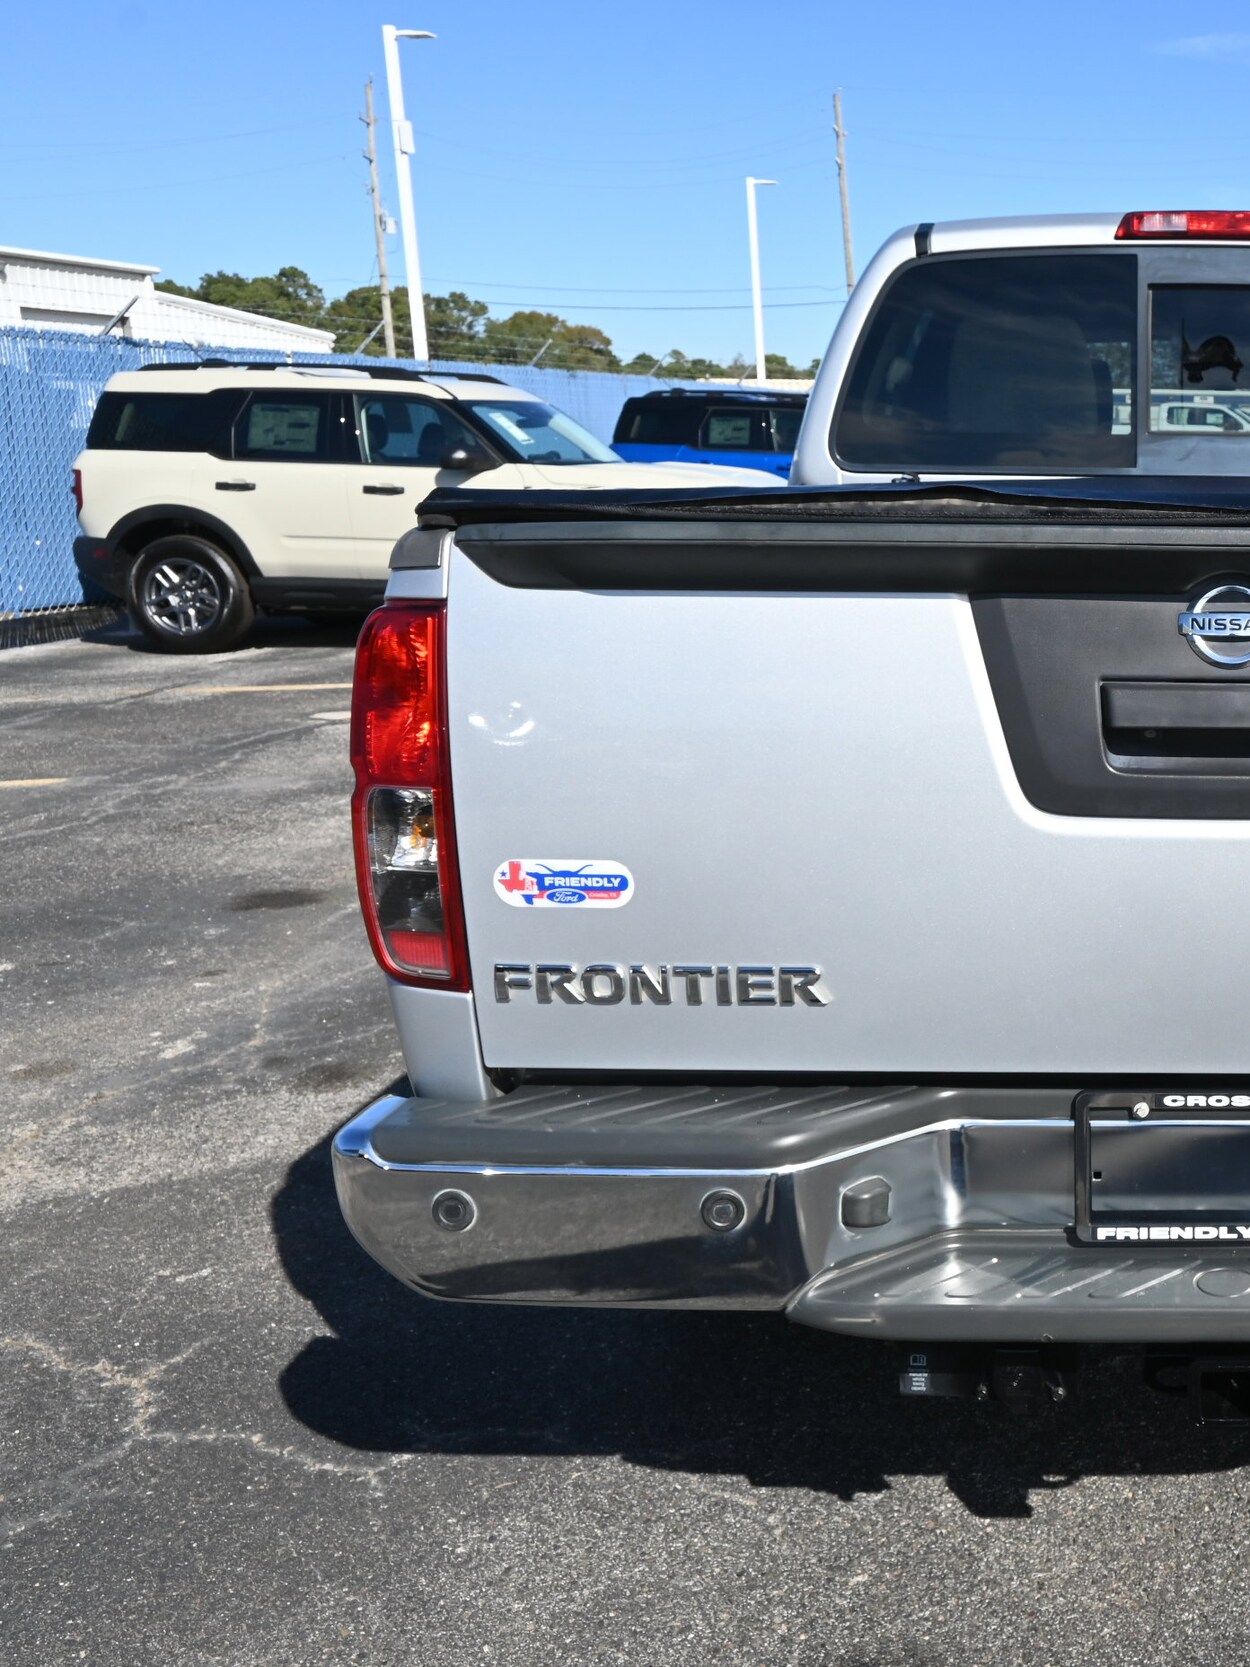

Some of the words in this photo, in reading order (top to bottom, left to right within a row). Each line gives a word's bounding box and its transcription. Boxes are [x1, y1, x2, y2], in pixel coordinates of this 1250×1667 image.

[544, 876, 622, 888] FRIENDLY
[553, 891, 579, 902] Ford
[494, 963, 832, 1007] FRONTIER
